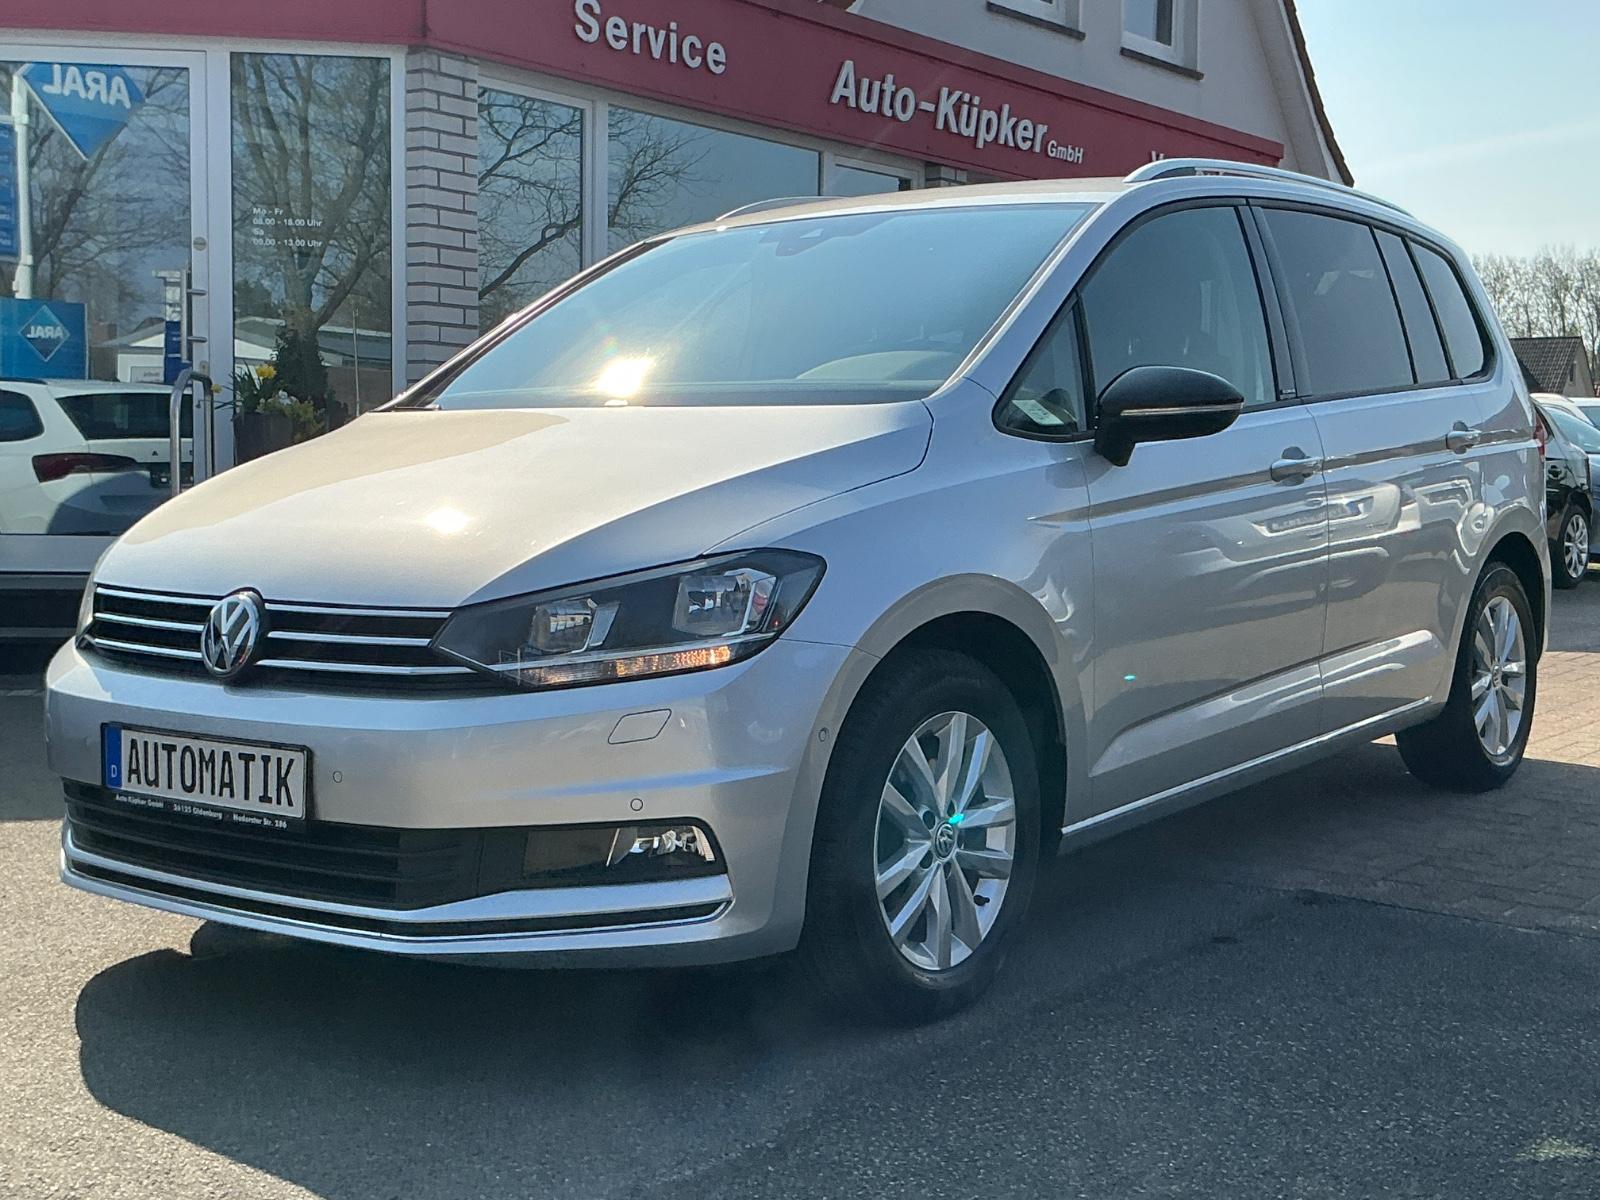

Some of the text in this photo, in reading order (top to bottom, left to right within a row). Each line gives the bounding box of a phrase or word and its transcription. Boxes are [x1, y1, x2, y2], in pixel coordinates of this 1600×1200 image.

[574, 0, 727, 75] Service
[830, 59, 1084, 165] Auto-Küpker GmbH
[274, 207, 283, 215] Fr
[307, 219, 322, 227] Uhr
[111, 737, 296, 808] D AUTOMATIK
